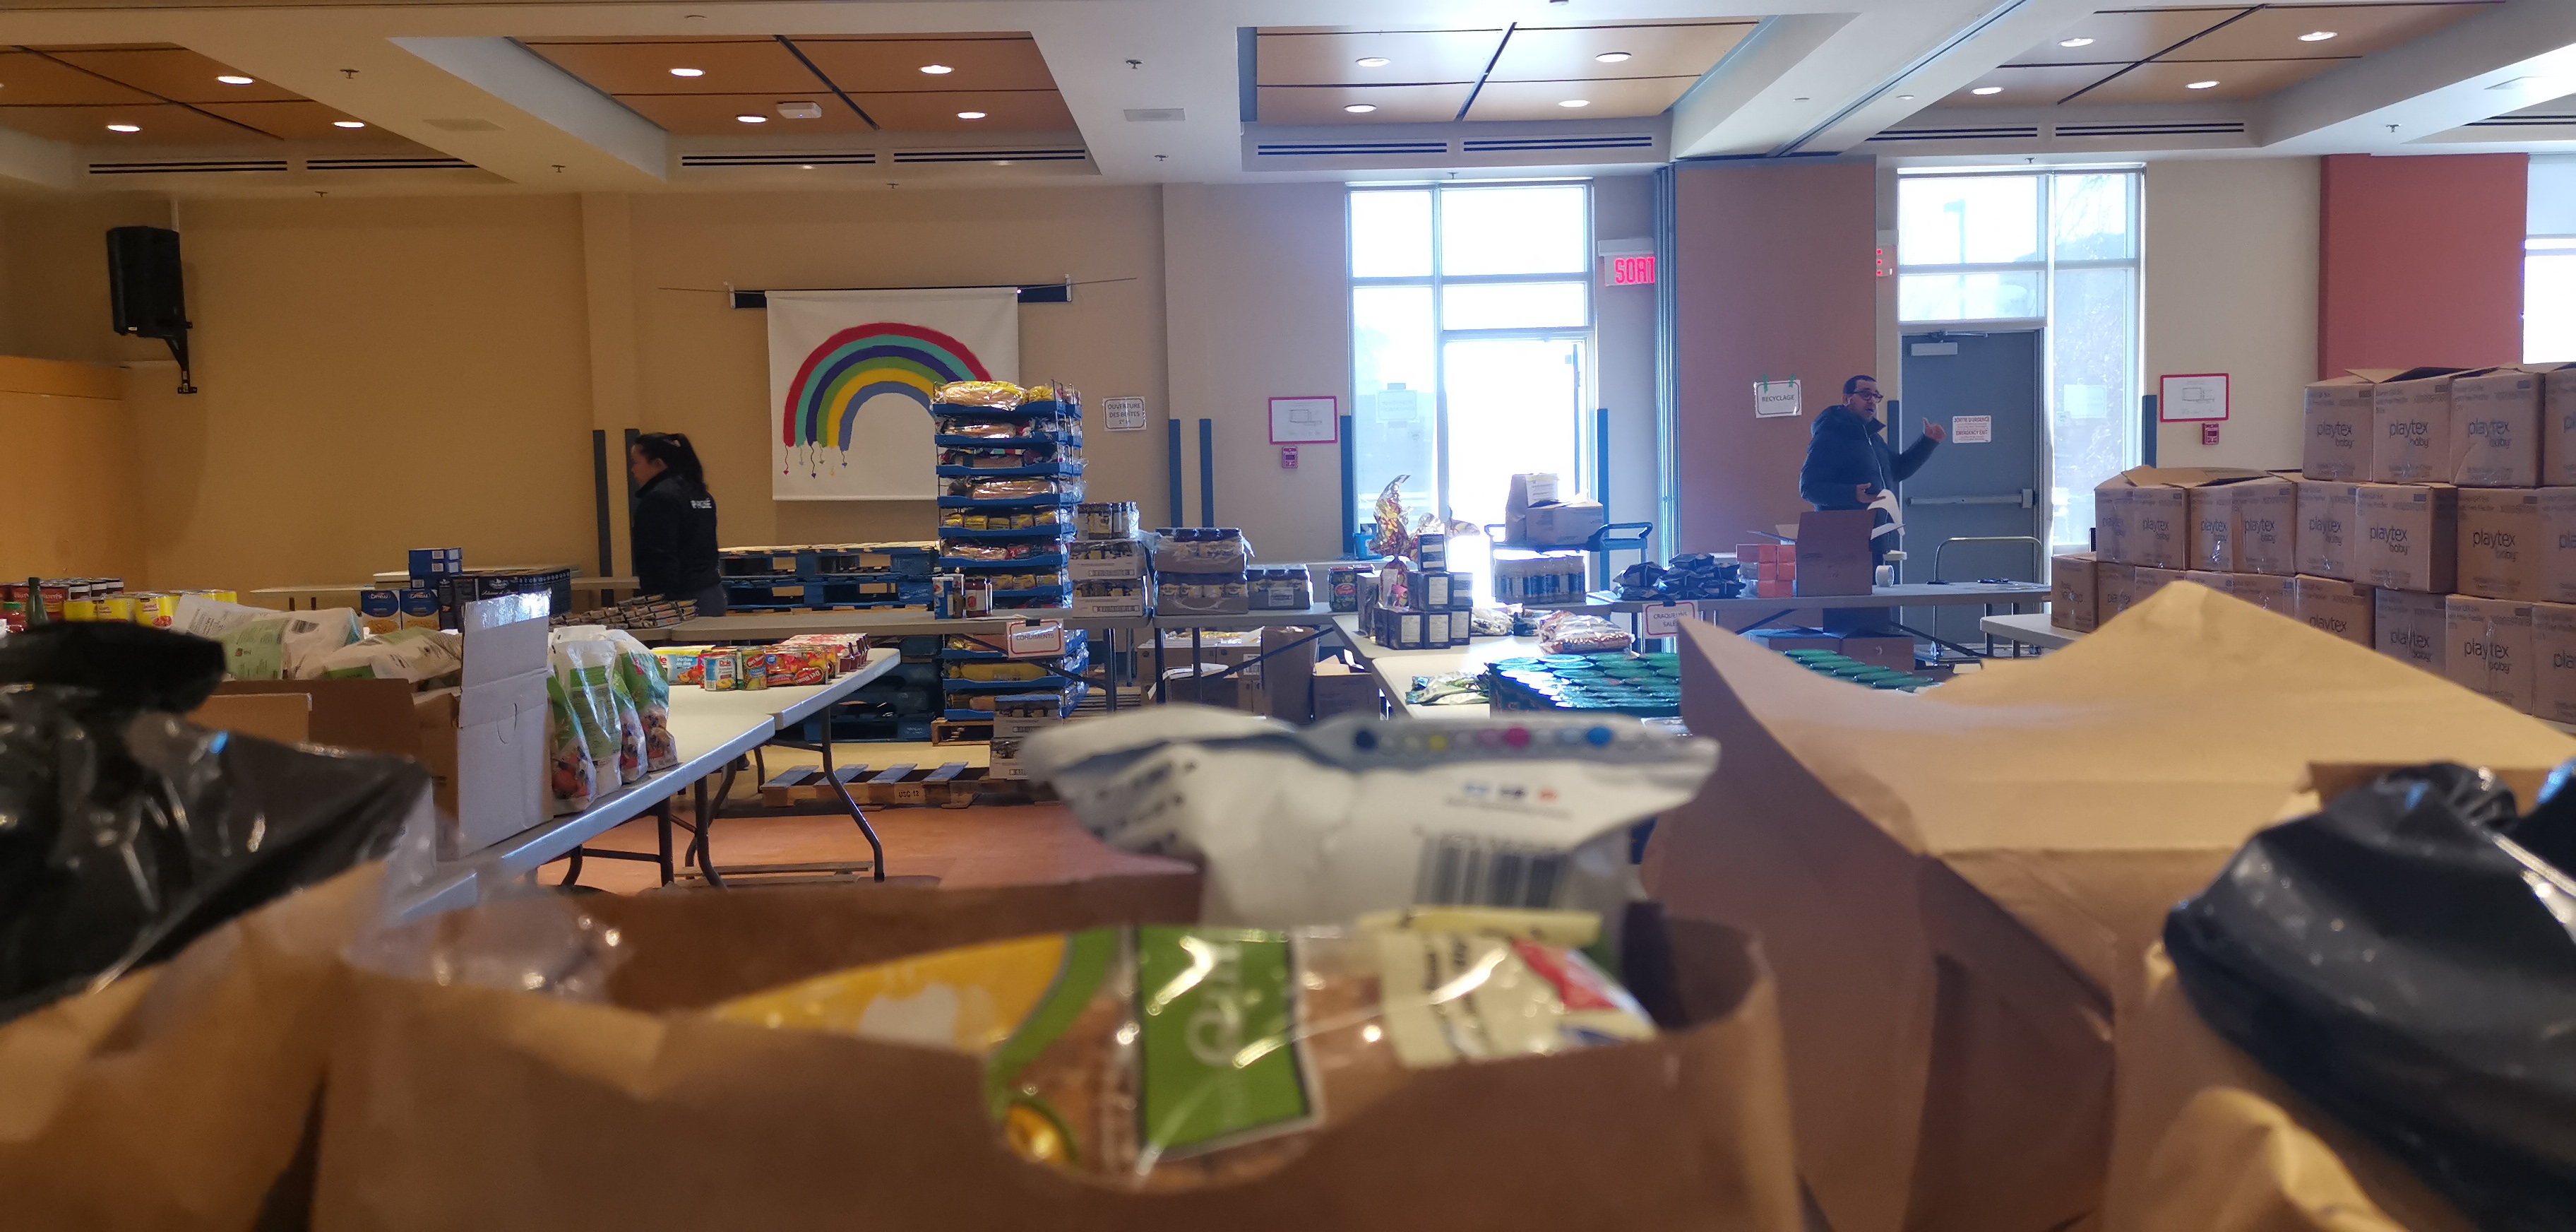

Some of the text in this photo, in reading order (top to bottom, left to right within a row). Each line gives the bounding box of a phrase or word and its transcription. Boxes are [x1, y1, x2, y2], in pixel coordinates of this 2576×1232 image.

[1614, 257, 1655, 284] SORT
[2317, 421, 2352, 438] playtex
[2390, 419, 2428, 438] playtex
[2468, 418, 2509, 438] playtex
[2335, 438, 2353, 449] baby
[2142, 517, 2169, 532] playtex
[2201, 517, 2227, 533] playtex
[2244, 518, 2274, 534] playtex
[2309, 516, 2342, 534] playtex
[2370, 523, 2407, 543] playtex
[2473, 528, 2515, 549] playtex
[2390, 542, 2408, 555] baby
[2390, 628, 2430, 649] playtex
[2464, 638, 2509, 660] playtex
[810, 670, 821, 679] Del
